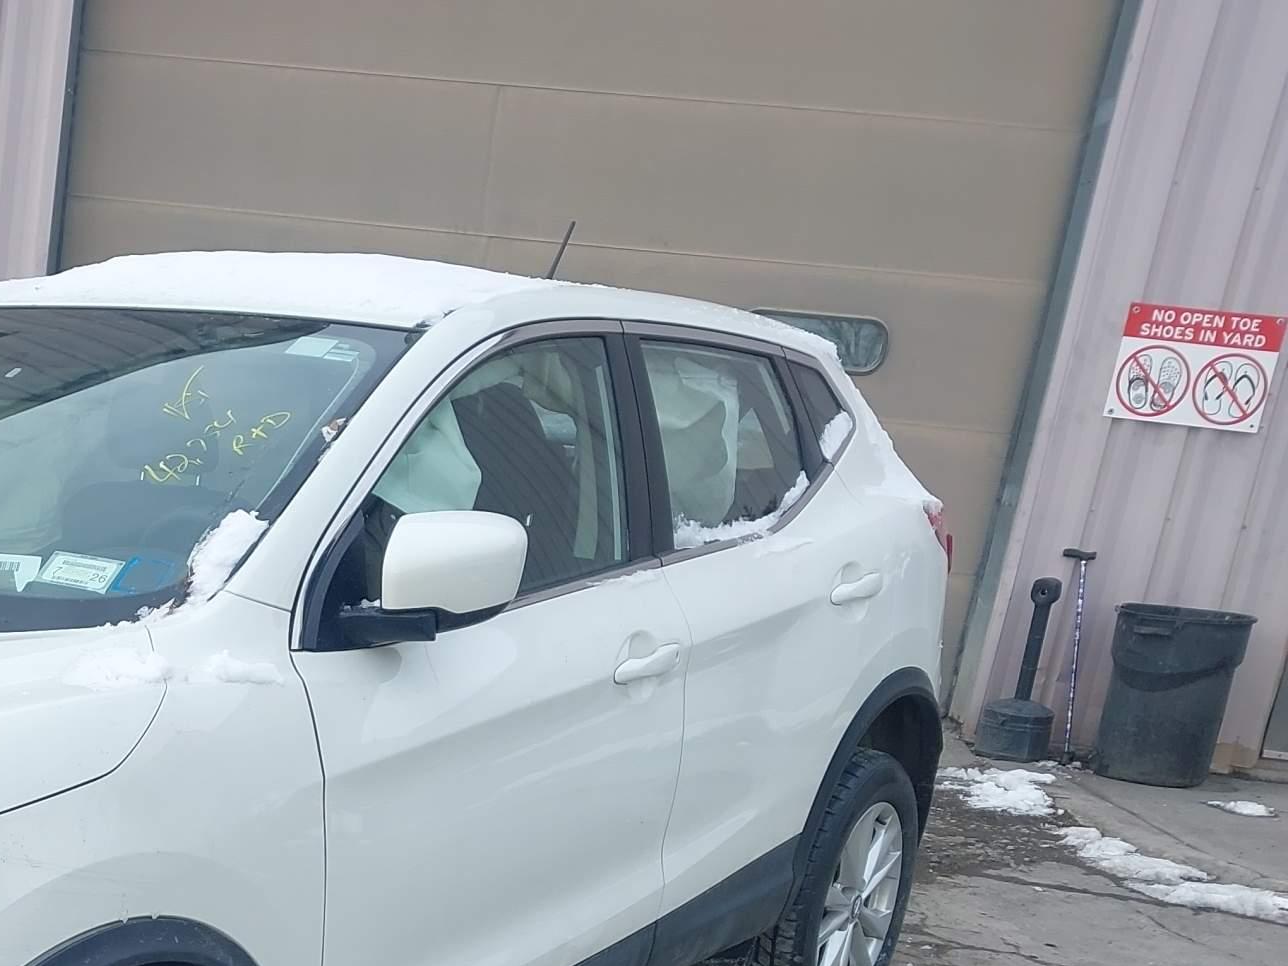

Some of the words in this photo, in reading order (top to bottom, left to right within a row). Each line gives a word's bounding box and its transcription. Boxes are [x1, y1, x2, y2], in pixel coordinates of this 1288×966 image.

[1152, 309, 1176, 323] NO
[1180, 312, 1225, 328] OPEN
[1231, 316, 1262, 332] TOE
[1140, 323, 1194, 341] SHOES
[1199, 329, 1216, 343] IN
[1222, 332, 1266, 348] YARD
[90, 572, 108, 584] 26
